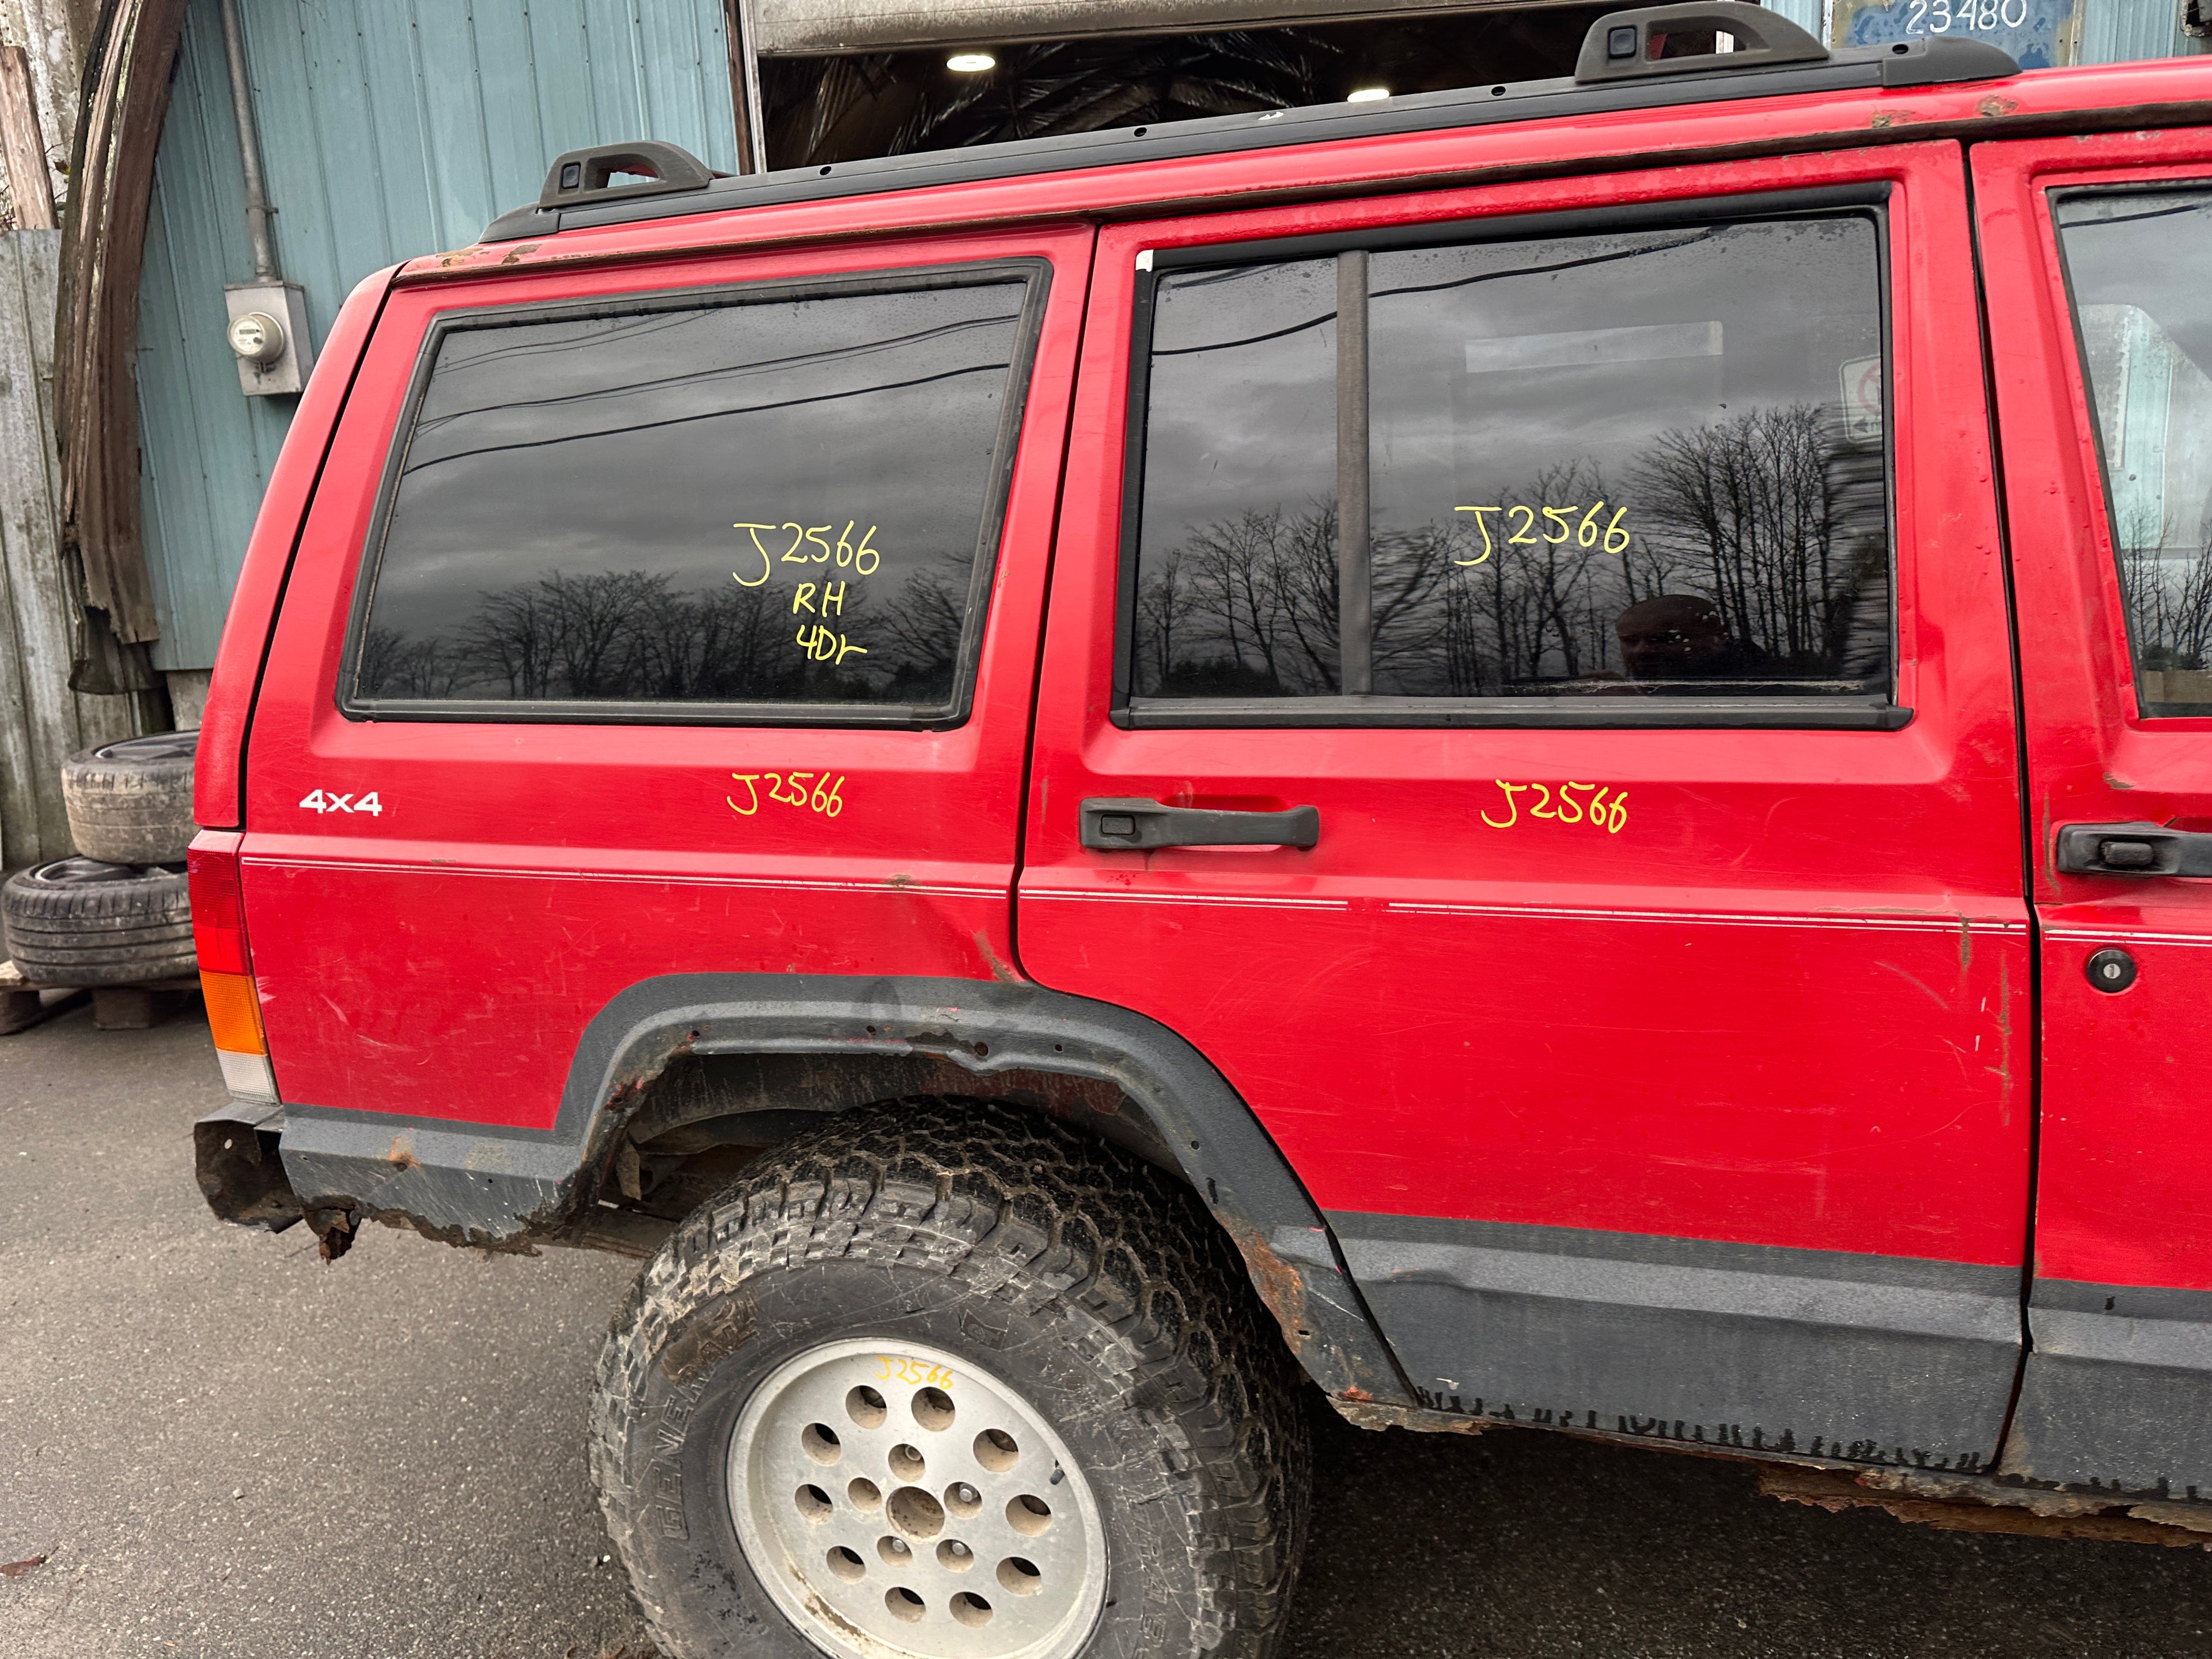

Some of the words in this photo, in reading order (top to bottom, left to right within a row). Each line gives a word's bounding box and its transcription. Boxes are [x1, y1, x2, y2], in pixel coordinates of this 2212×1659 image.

[1906, 0, 2027, 35] 23480
[732, 520, 880, 586] J2566
[1454, 501, 1630, 566] J2566
[793, 580, 845, 617] RH
[726, 771, 846, 817] J2566
[1480, 779, 1628, 834] J2566
[876, 1354, 954, 1390] J2566
